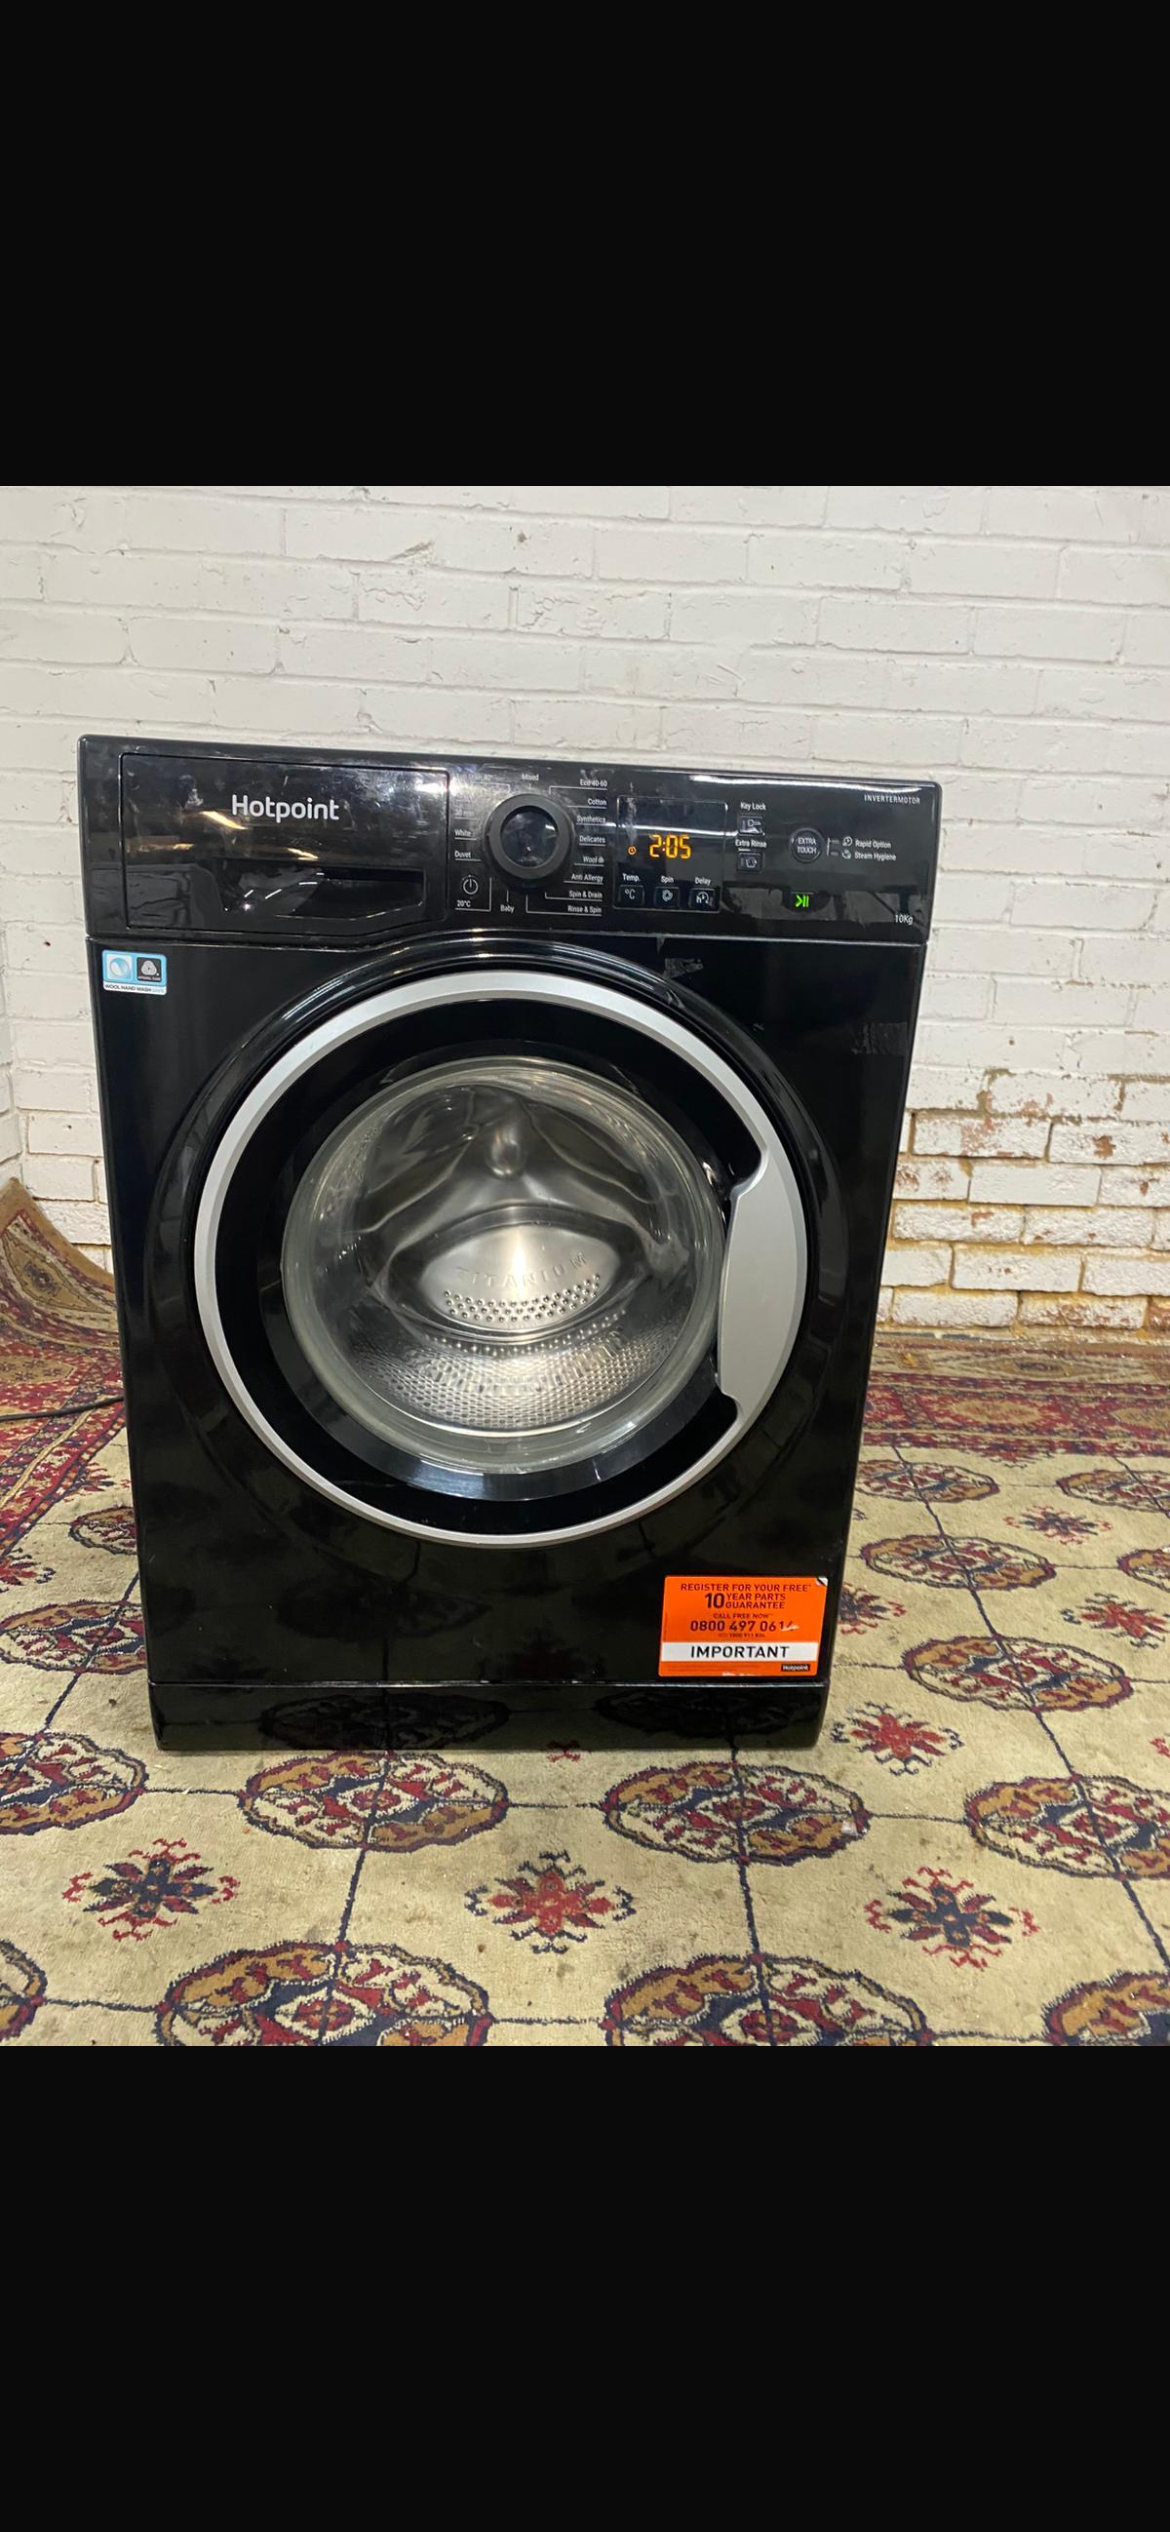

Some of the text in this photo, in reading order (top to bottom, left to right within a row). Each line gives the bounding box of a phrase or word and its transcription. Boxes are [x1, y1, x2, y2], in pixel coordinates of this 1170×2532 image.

[521, 773, 539, 781] Mixed
[587, 798, 607, 806] Cotton
[864, 794, 921, 804] INVERTERMOTOR
[232, 794, 340, 823] Hotpoint
[740, 802, 766, 811] Key Lock
[576, 814, 606, 824] Synthetics
[454, 828, 471, 837] White
[579, 835, 606, 843] Delicates
[798, 837, 817, 845] EXTRA
[649, 834, 692, 859] 2:05
[735, 839, 767, 849] Extra Rinse
[855, 840, 891, 849] Rapid Option
[454, 850, 471, 858] Duvet
[797, 846, 817, 854] TOUCH
[583, 855, 598, 863] Wool
[854, 851, 896, 861] Steam Hygiene
[584, 874, 604, 883] Allergy
[622, 873, 641, 882] Temp.
[661, 875, 674, 884] Spin
[694, 877, 711, 886] Delay
[569, 890, 603, 899] Spin & Drain
[500, 904, 515, 913] Baby
[584, 905, 589, 913] &
[589, 906, 602, 914] Spin
[895, 914, 913, 925] 10Kg
[456, 1250, 588, 1288] TITANIUM
[680, 1583, 729, 1591] REGISTER
[732, 1583, 751, 1592] FOR
[754, 1584, 780, 1592] YOUR
[705, 1593, 786, 1609] 10 YEAR PARTS
[725, 1601, 785, 1609] GUARANTEE
[690, 1620, 725, 1632] 0800
[729, 1620, 756, 1632] 497
[690, 1646, 790, 1659] IMPORTANT
